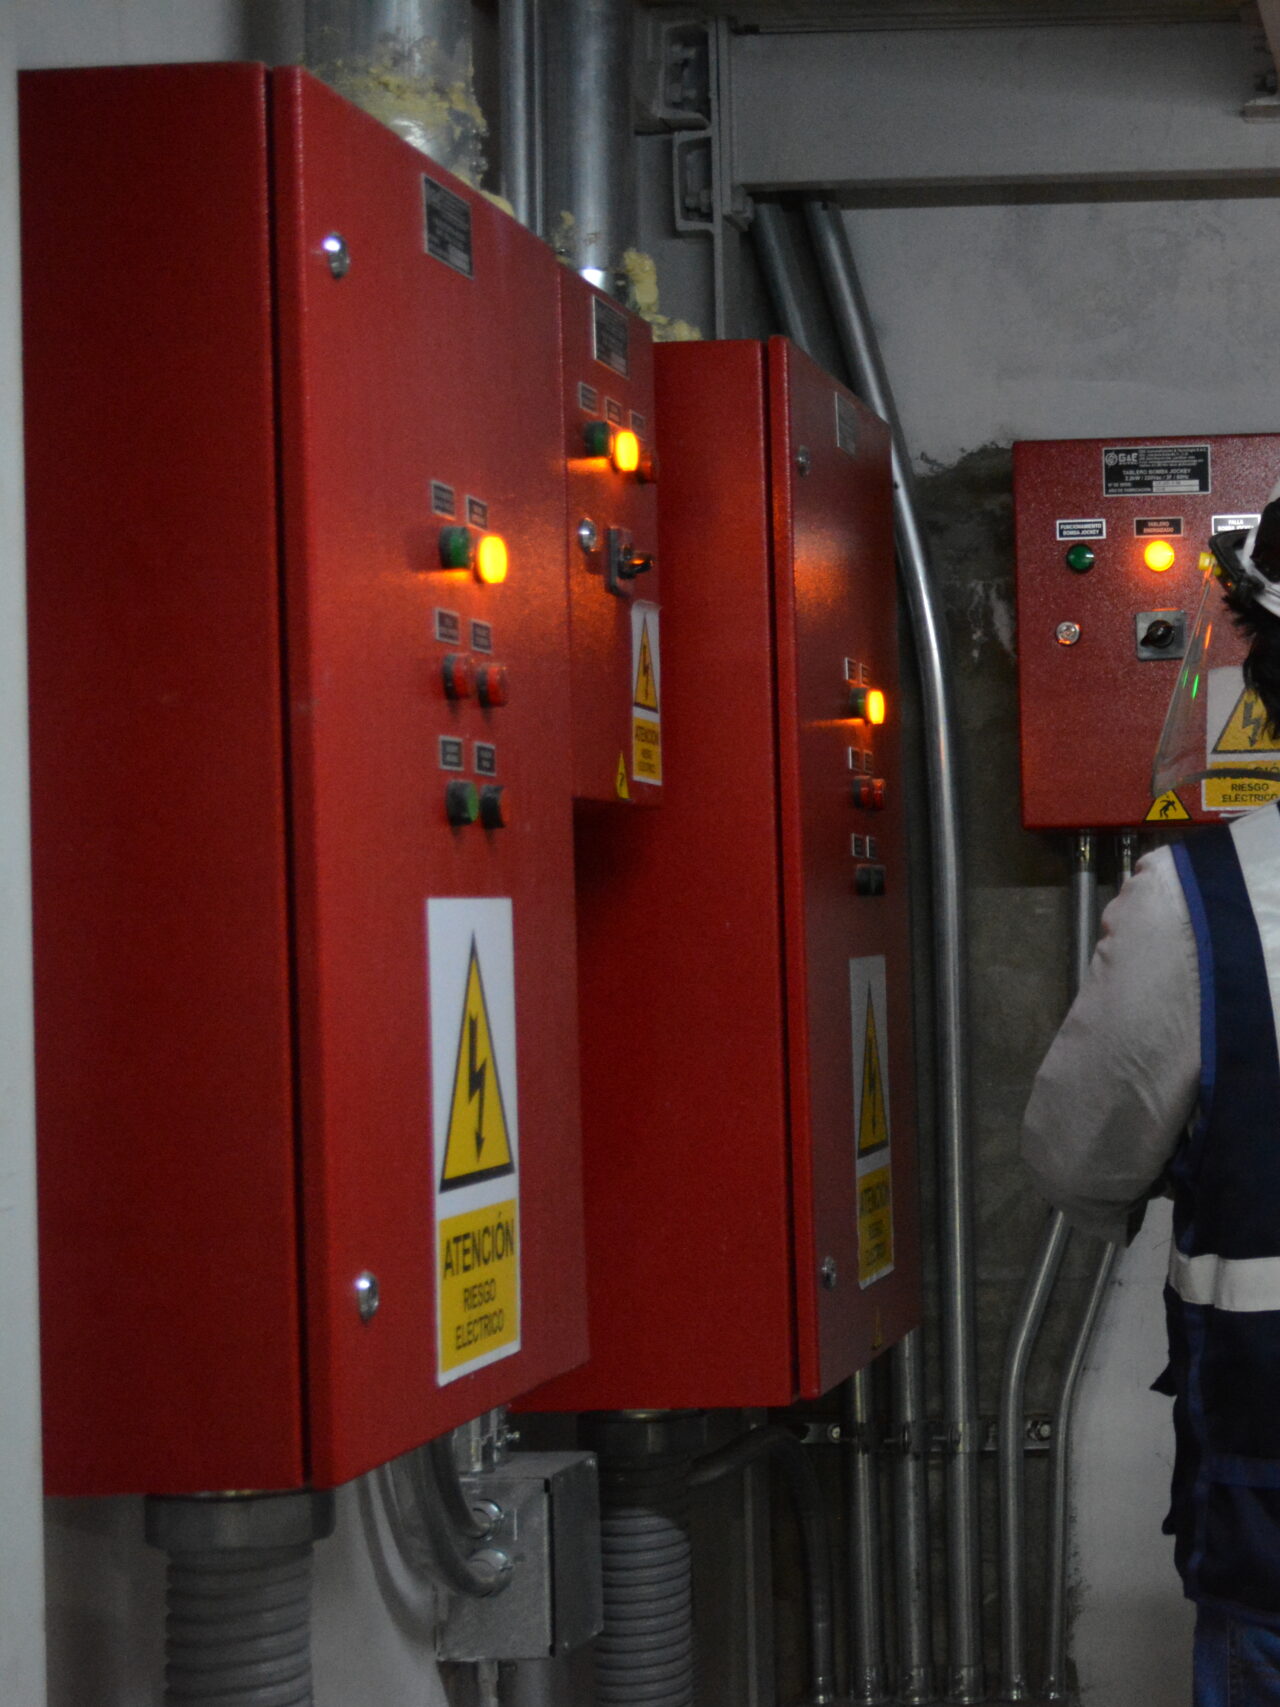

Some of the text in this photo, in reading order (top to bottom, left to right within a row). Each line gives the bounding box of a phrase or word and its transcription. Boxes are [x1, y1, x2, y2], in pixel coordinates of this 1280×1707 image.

[1231, 783, 1269, 791] RIESGO
[444, 1212, 514, 1278] ATENCIÓN
[464, 1278, 497, 1312] RIESGO
